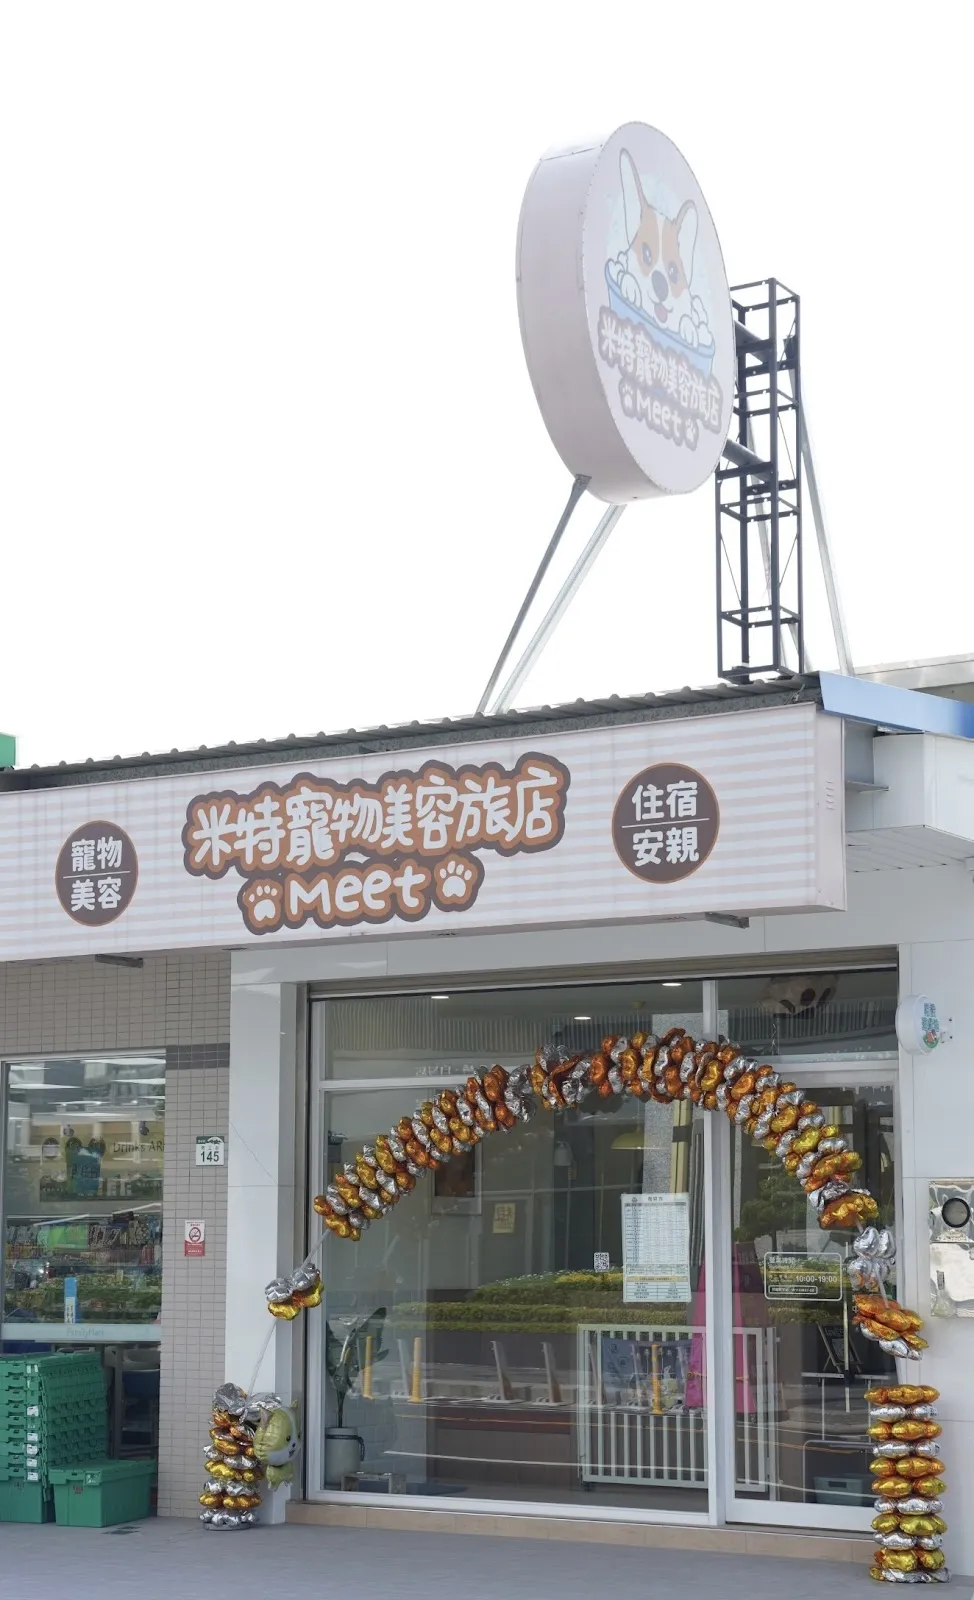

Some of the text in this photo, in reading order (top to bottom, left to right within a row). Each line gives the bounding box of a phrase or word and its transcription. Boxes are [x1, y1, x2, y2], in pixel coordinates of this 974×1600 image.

[636, 388, 683, 438] Meet
[192, 765, 558, 866] 米特寵物美容旅店
[631, 780, 699, 822] 住宿
[71, 836, 123, 872] 寵物
[632, 826, 700, 868] 安親
[70, 876, 122, 912] 美容
[289, 865, 426, 916] Meet
[200, 1150, 220, 1162] 145
[795, 1275, 838, 1283] 10:00-19:00
